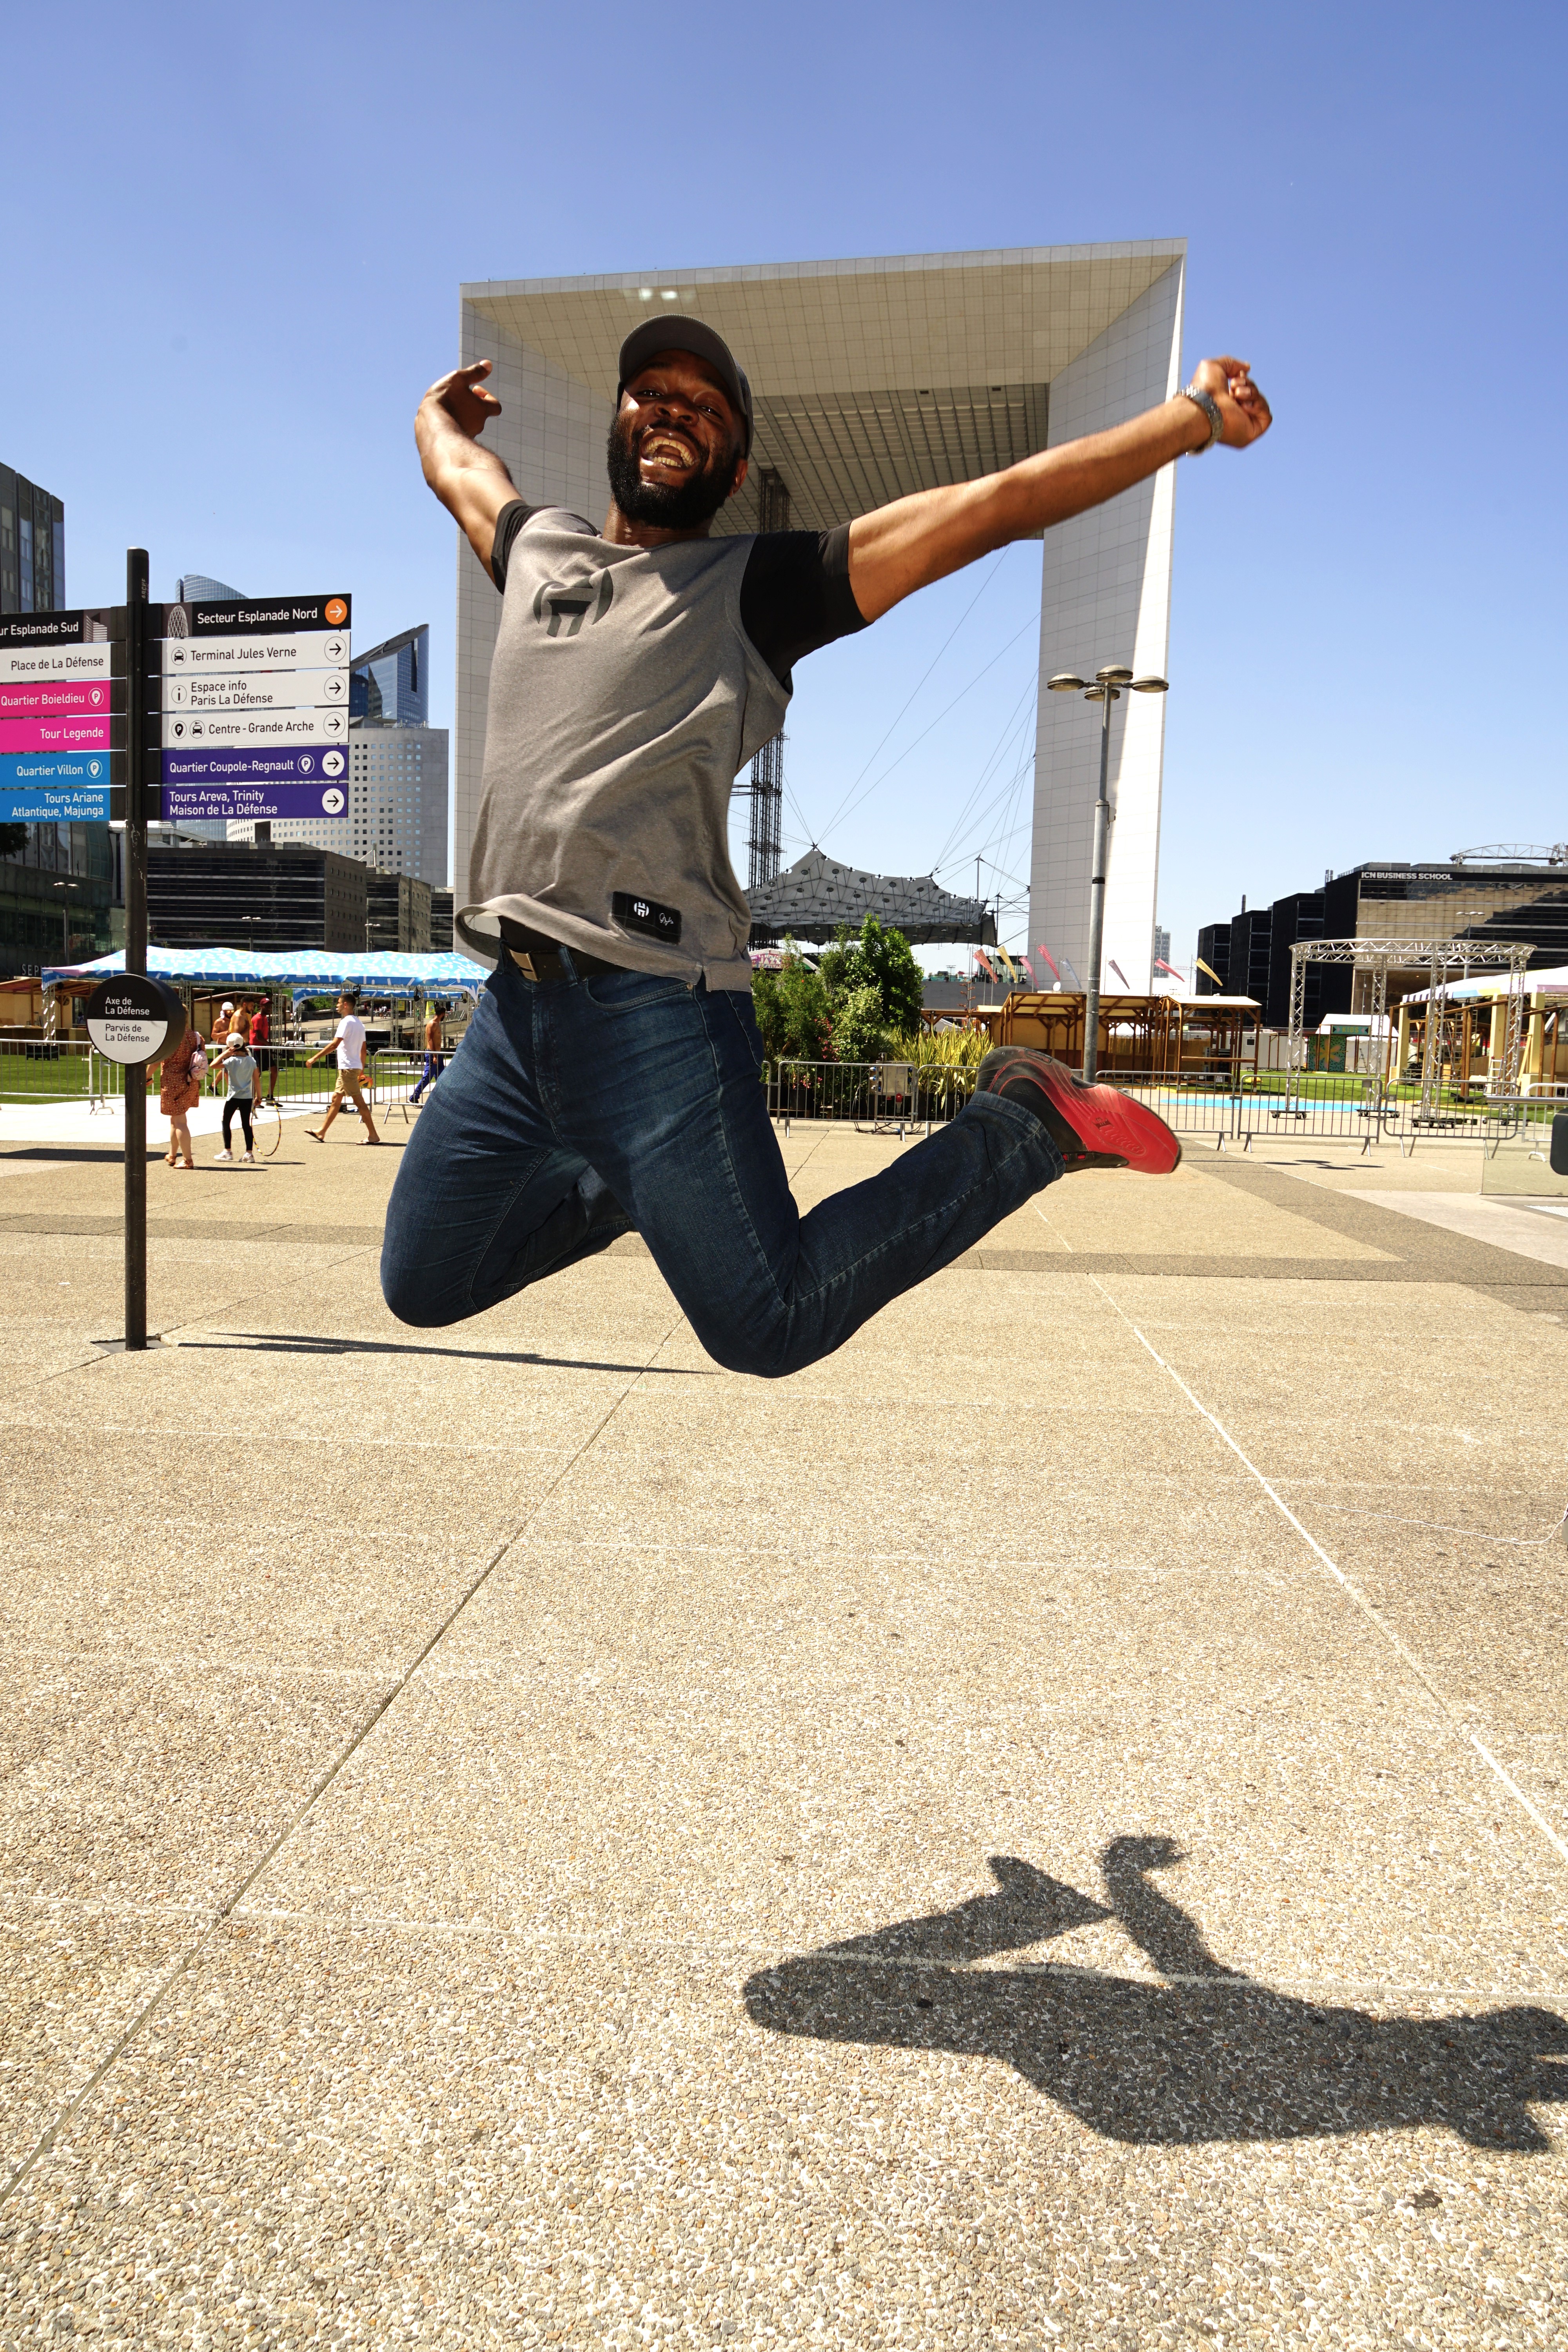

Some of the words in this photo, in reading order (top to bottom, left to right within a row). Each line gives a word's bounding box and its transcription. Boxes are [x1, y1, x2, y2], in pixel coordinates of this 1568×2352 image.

[198, 613, 236, 624] Secteur
[238, 609, 289, 624] Esplanade
[293, 608, 318, 619] Nord
[11, 623, 58, 637] Esplanade
[61, 621, 78, 632] Sud
[191, 649, 235, 661] Terminal
[237, 648, 264, 659] Jules
[267, 647, 297, 657] Verne
[11, 661, 36, 671] Place
[39, 659, 49, 669] de
[53, 659, 63, 668] La
[66, 656, 104, 668] Défense
[191, 682, 225, 694] Espace
[229, 680, 247, 690] info
[1, 695, 39, 706] Quartier
[42, 693, 84, 704] Boieldieu
[191, 695, 216, 705] Paris
[219, 695, 230, 704] La
[234, 693, 273, 704] Défense
[40, 729, 61, 739] Tour
[64, 727, 104, 740] Legende
[209, 724, 240, 734] Centre
[249, 722, 283, 733] Grande
[286, 721, 314, 731] Arche
[17, 765, 55, 776] Quartier
[57, 764, 83, 775] Villon
[170, 762, 208, 773] Quartier
[210, 760, 294, 774] Coupole-Regnault
[44, 793, 70, 803] Tours
[73, 792, 103, 802] Ariane
[169, 791, 196, 802] Tours
[199, 791, 230, 802] Areva,
[232, 790, 264, 803] Trinity
[12, 806, 62, 818] Atlantique,
[64, 805, 103, 818] Majunga
[170, 804, 204, 815] Maison
[207, 804, 219, 815] de
[222, 804, 234, 815] La
[237, 803, 278, 815] Défense
[105, 996, 120, 1005] Axe
[122, 997, 132, 1005] de
[118, 1006, 150, 1015] Défense
[105, 1024, 130, 1032] Parvis
[118, 1033, 149, 1042] Défense
